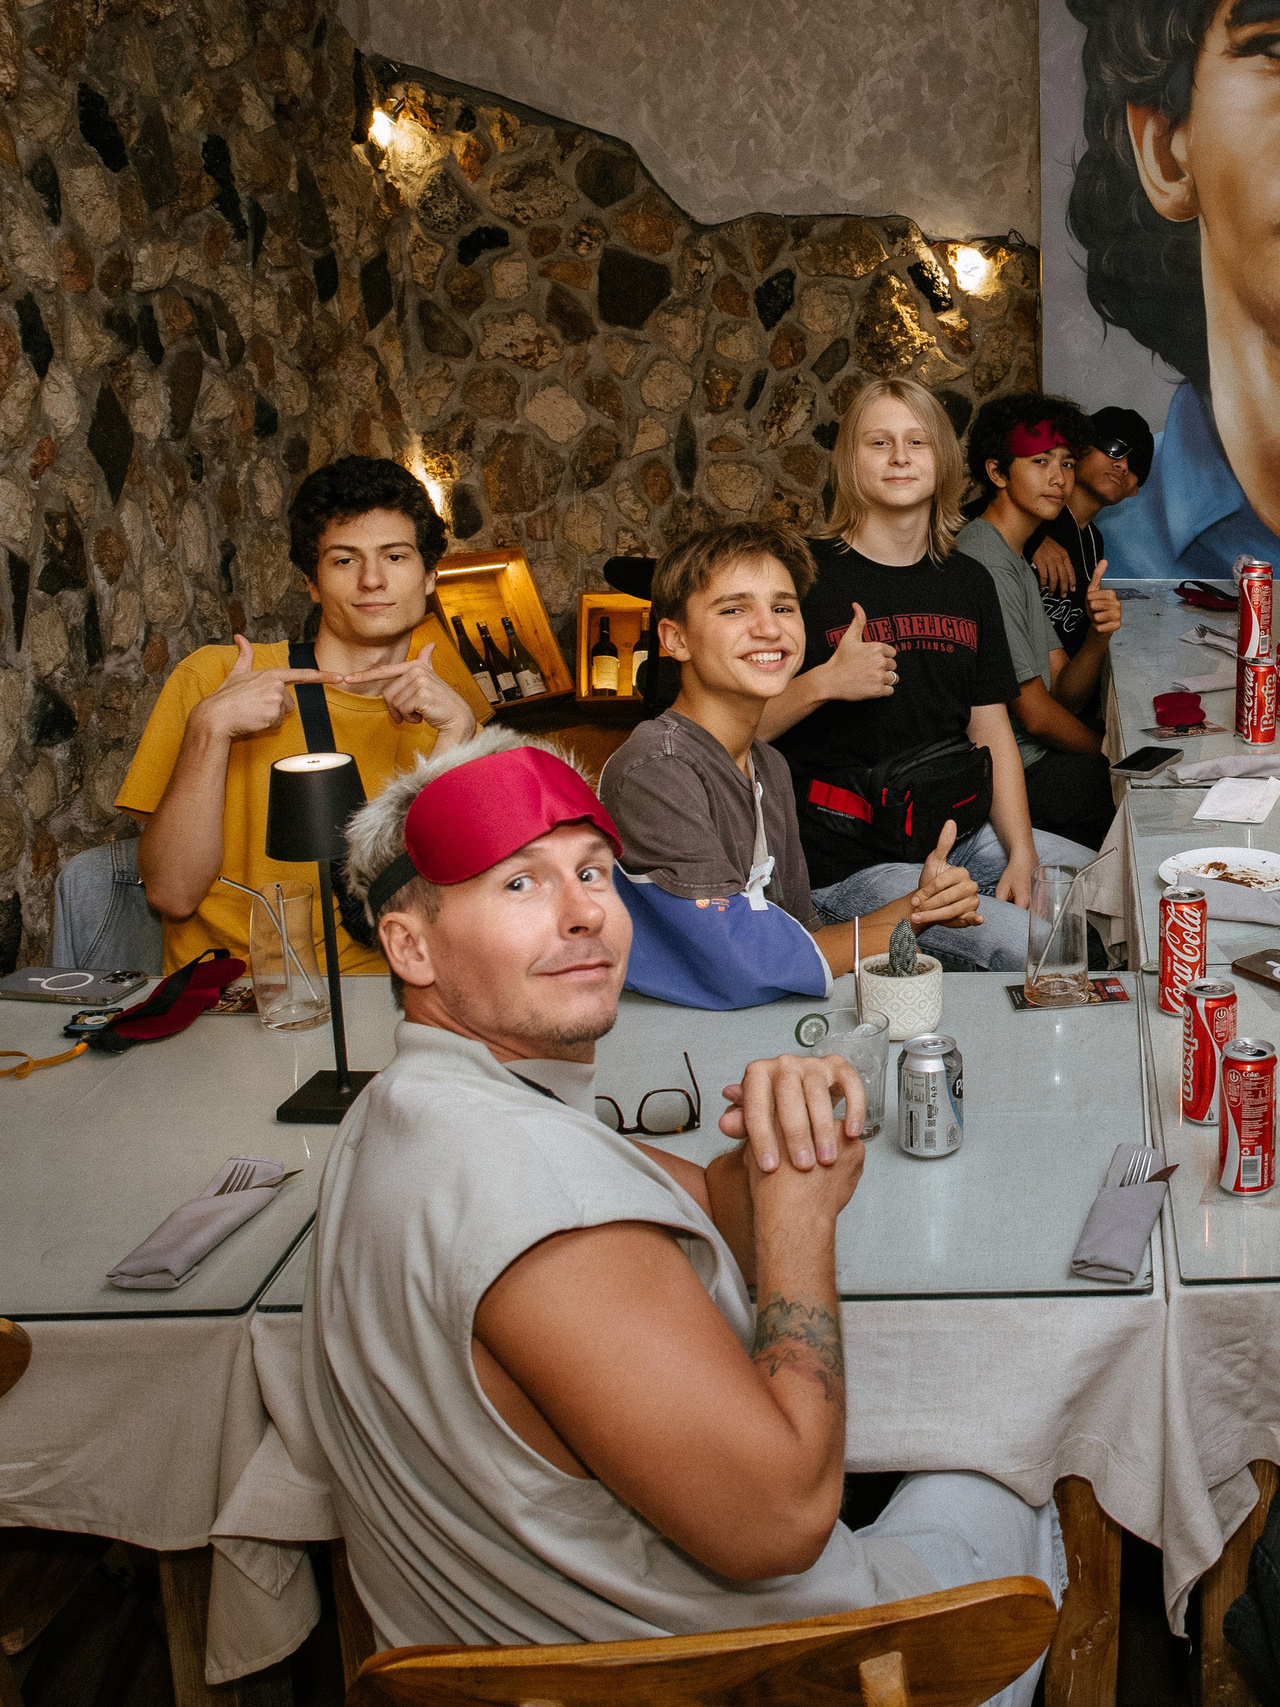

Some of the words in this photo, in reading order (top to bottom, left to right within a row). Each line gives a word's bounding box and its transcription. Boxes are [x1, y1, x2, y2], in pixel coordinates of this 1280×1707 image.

[827, 617, 892, 647] TUE
[896, 615, 978, 651] RELIGION
[1260, 674, 1277, 733] Bestie
